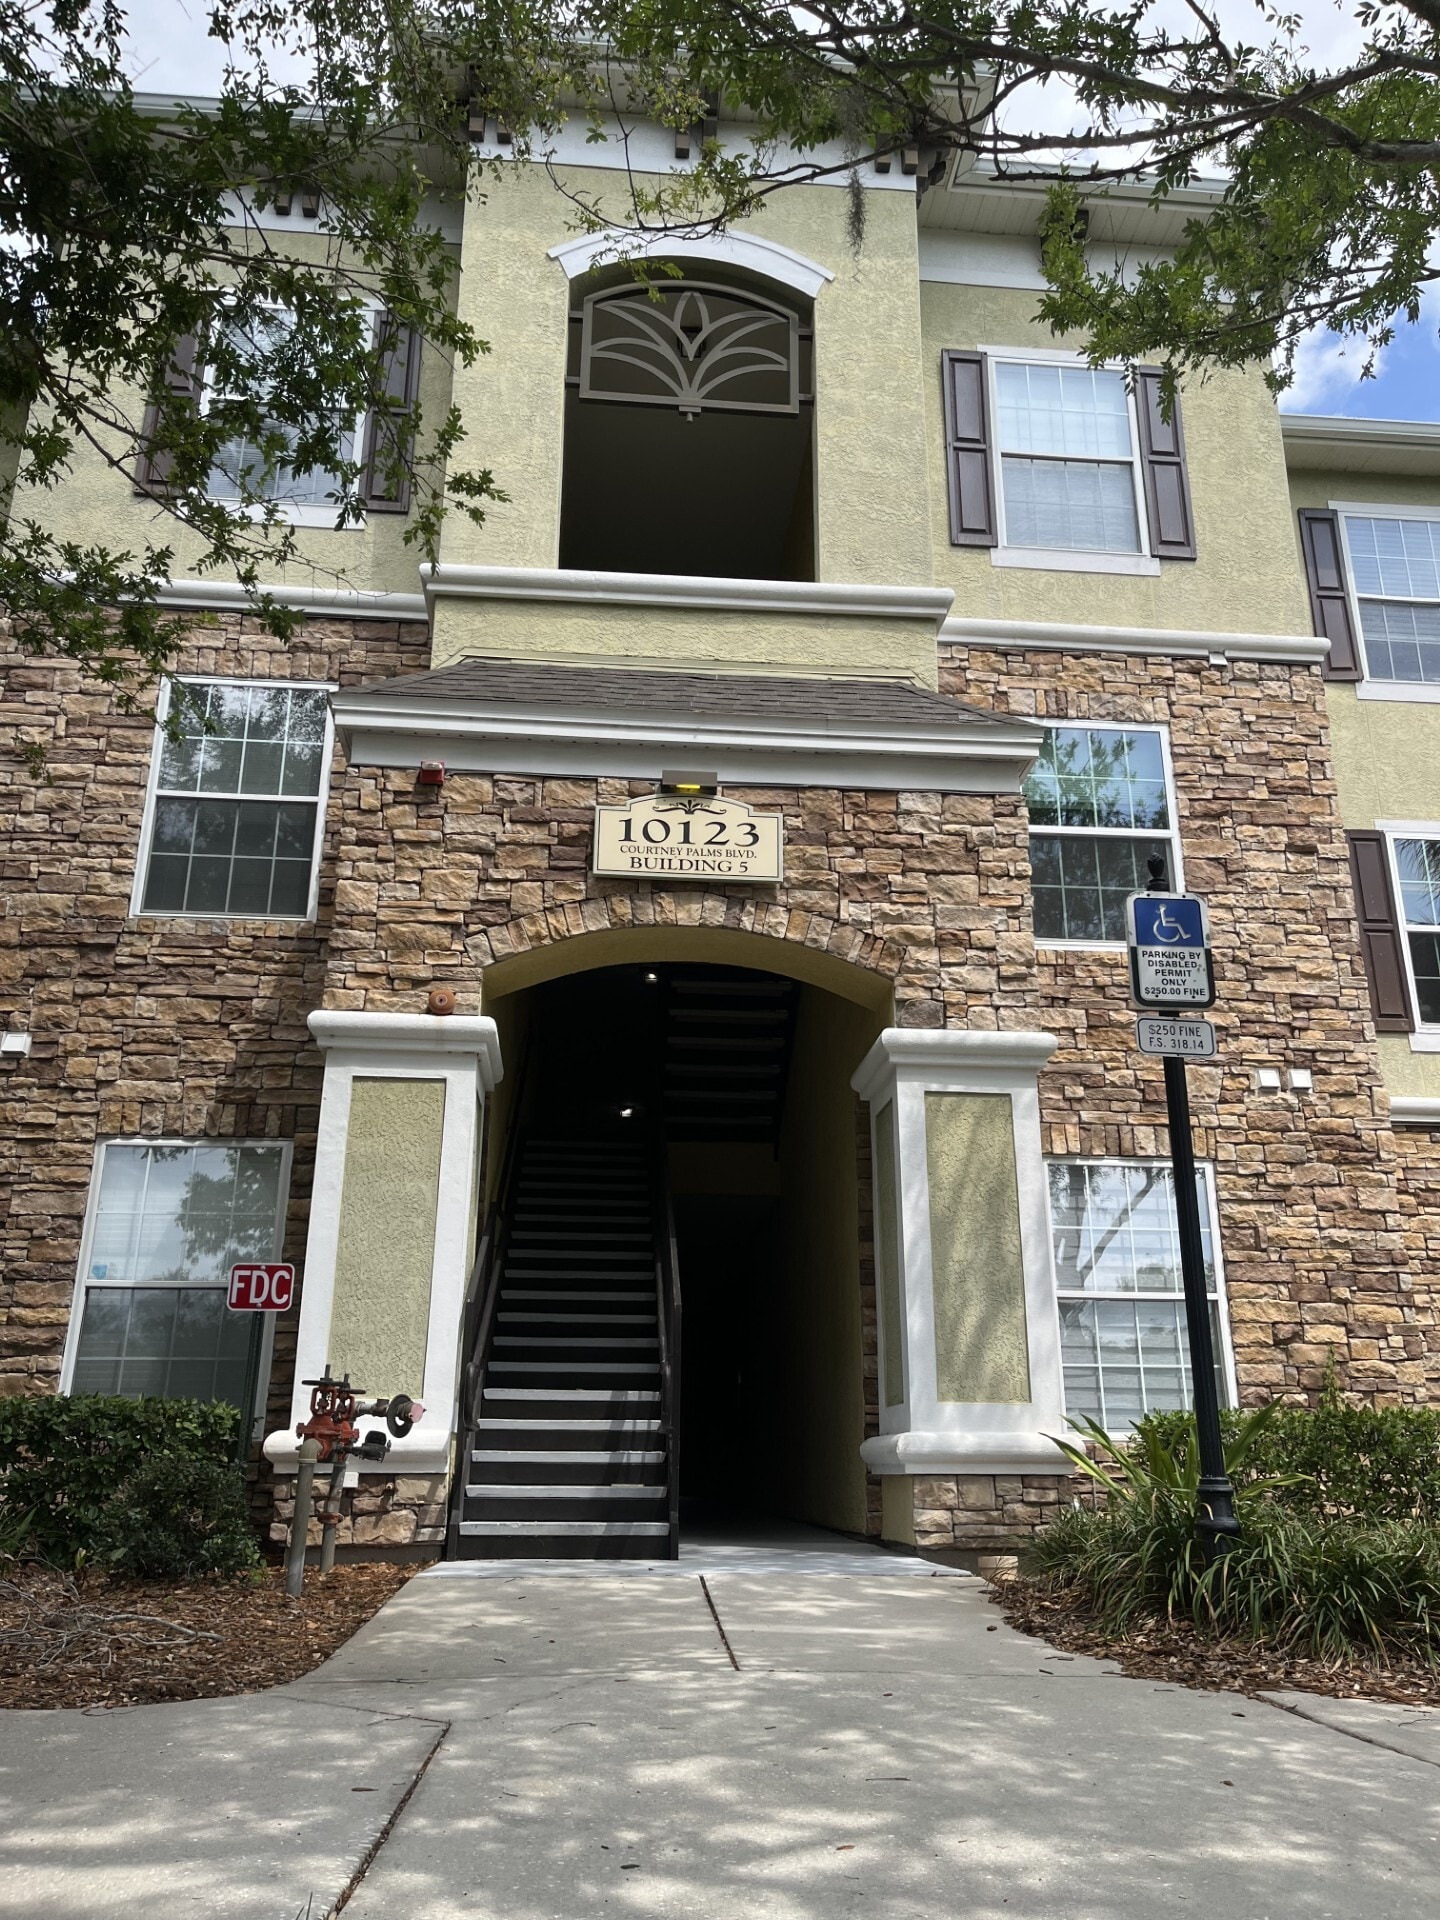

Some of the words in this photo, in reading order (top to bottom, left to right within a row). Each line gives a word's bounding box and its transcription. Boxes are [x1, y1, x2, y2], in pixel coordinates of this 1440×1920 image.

[618, 818, 760, 847] 10123
[620, 845, 683, 856] COURTNEY
[686, 848, 722, 858] PALMS
[725, 849, 757, 858] BLVD.
[630, 856, 732, 873] BUILDING
[738, 861, 748, 873] 5
[1142, 951, 1185, 960] PARKING
[1189, 952, 1201, 960] BY
[1148, 960, 1197, 968] DISABLED
[1155, 969, 1192, 977] PERMIT
[1161, 978, 1187, 986] ONLY
[1144, 987, 1181, 995] $250.00
[1183, 988, 1206, 996] FINE
[1148, 1024, 1176, 1036] $250
[1179, 1026, 1202, 1037] FINE
[1149, 1037, 1167, 1048] F.S.
[1170, 1038, 1204, 1050] 318.14
[231, 1270, 291, 1304] FDC
